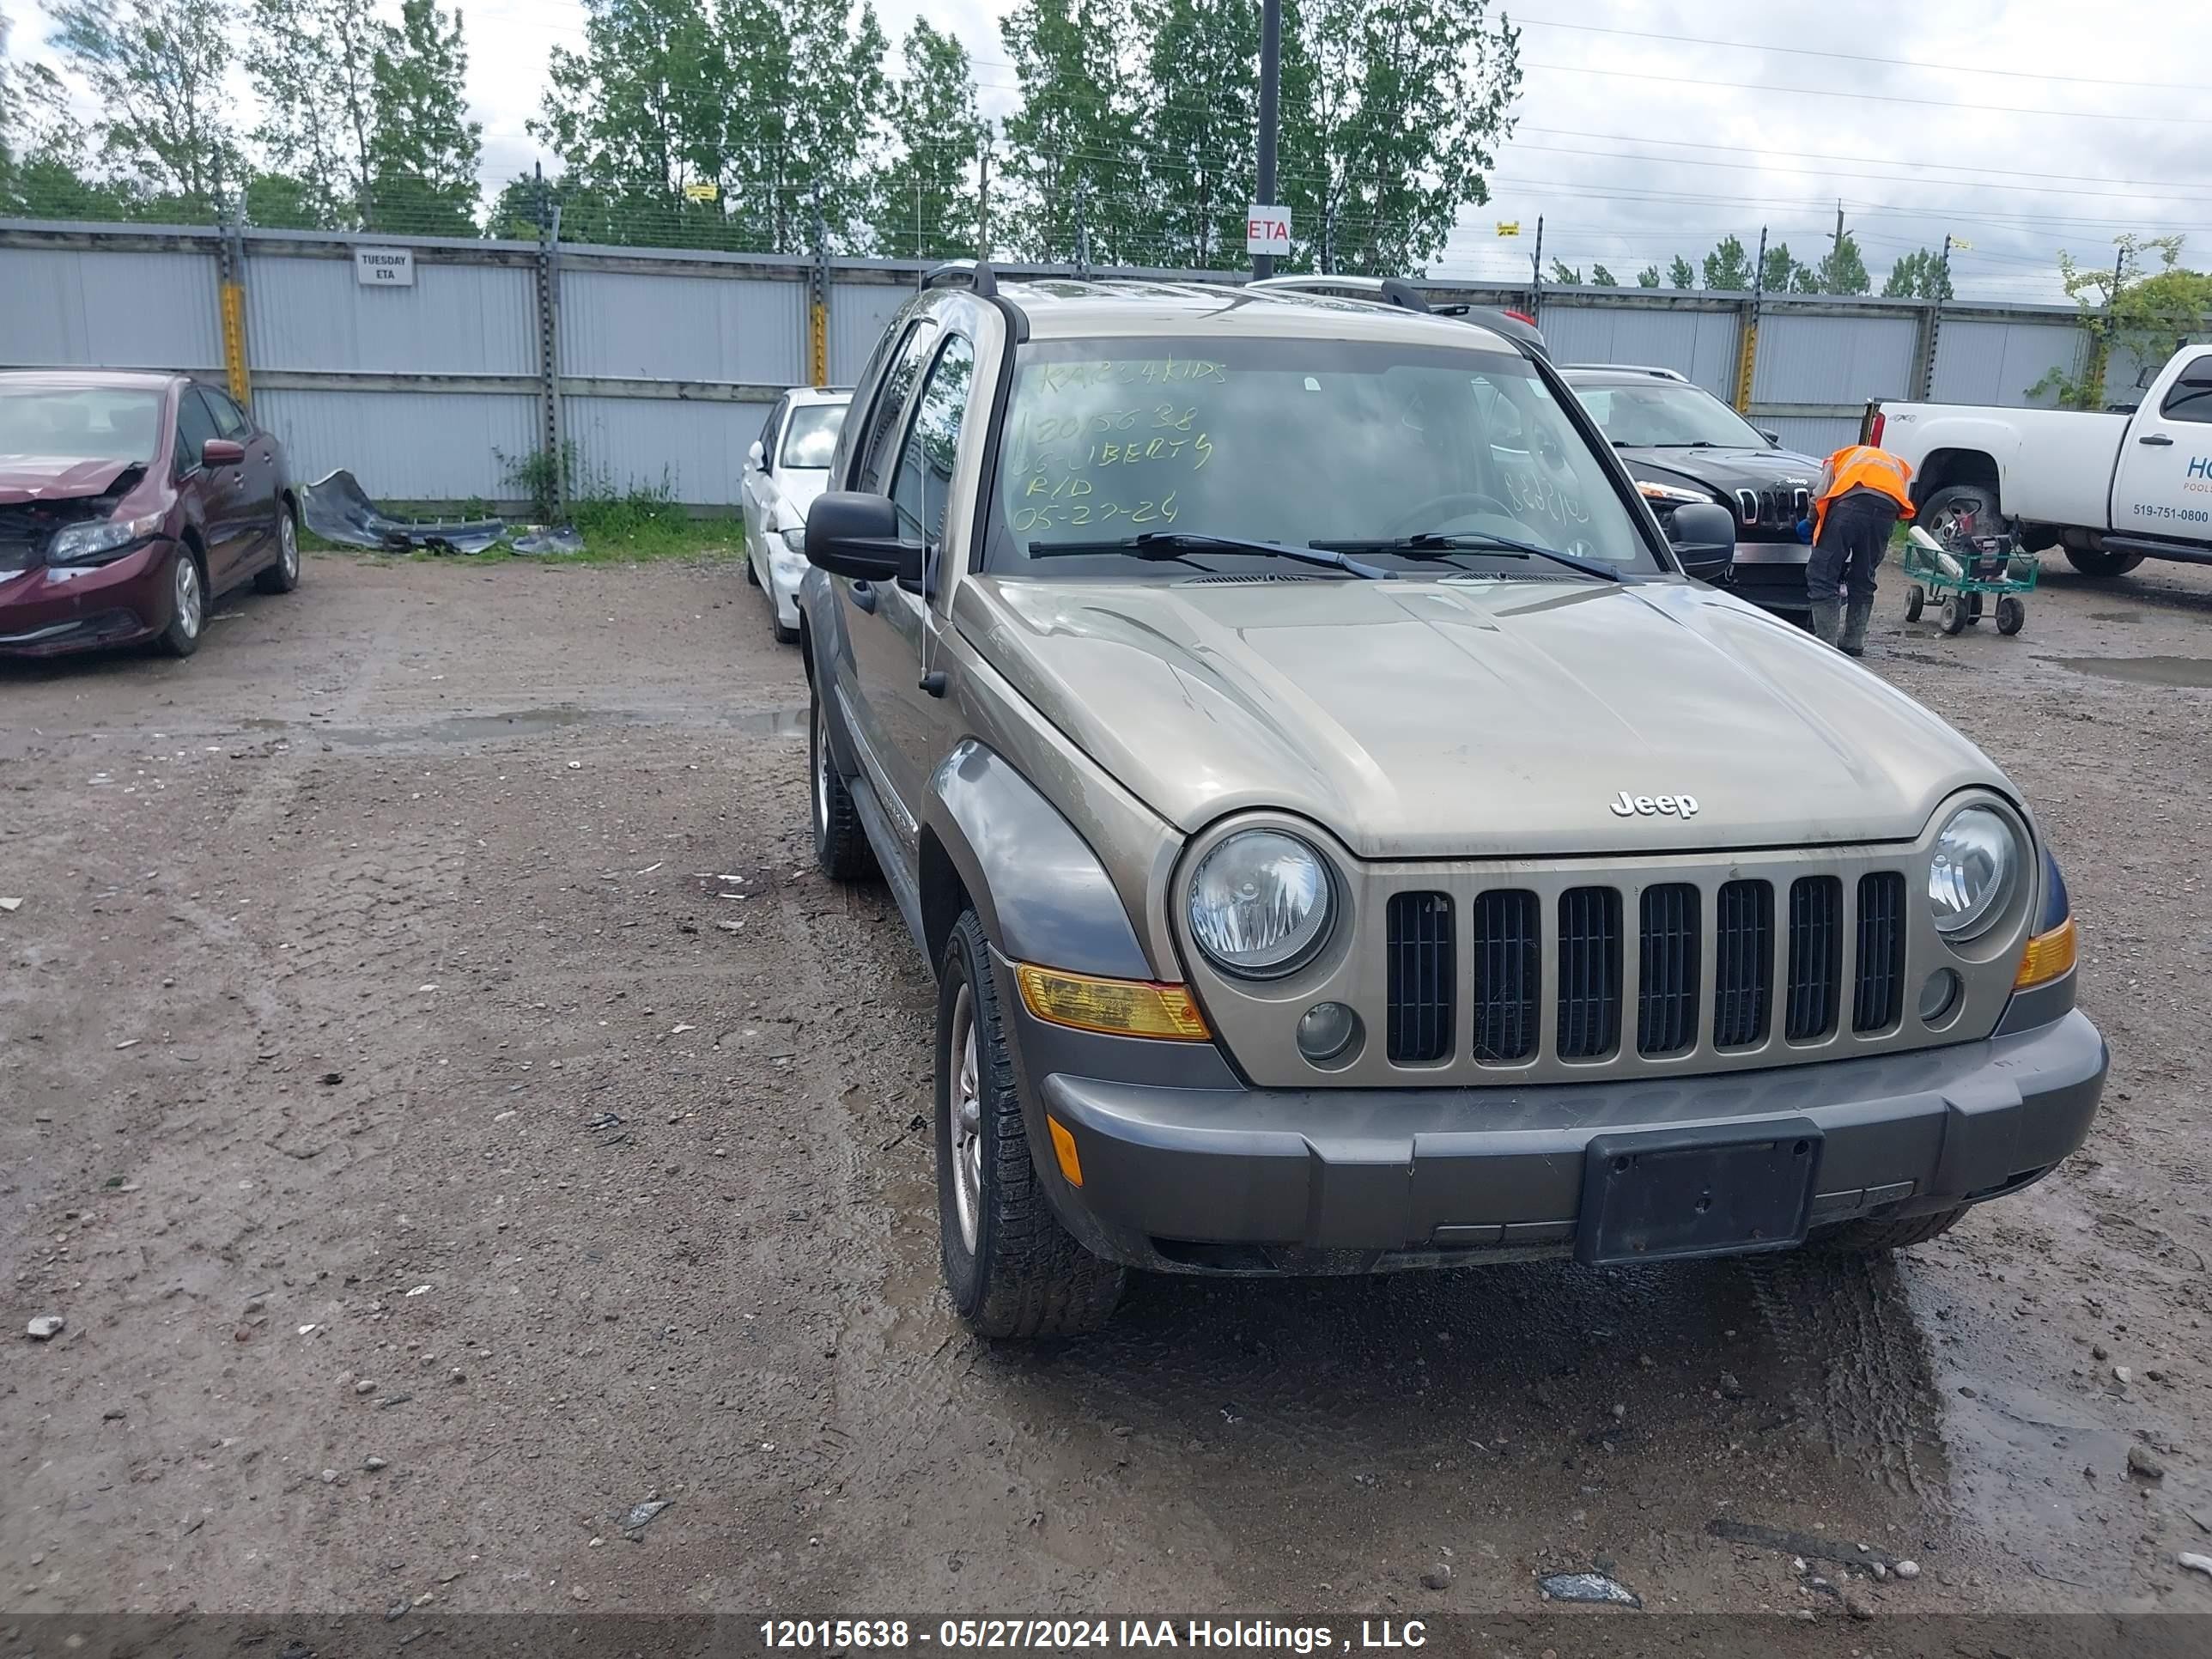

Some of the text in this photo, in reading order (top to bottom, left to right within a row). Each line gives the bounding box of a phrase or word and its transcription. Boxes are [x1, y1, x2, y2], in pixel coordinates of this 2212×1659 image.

[1249, 221, 1288, 240] ETA
[362, 255, 405, 265] TUESDAY
[376, 270, 395, 279] ETA
[2133, 504, 2209, 523] 519-751-0800
[1609, 791, 1699, 820] Jeep
